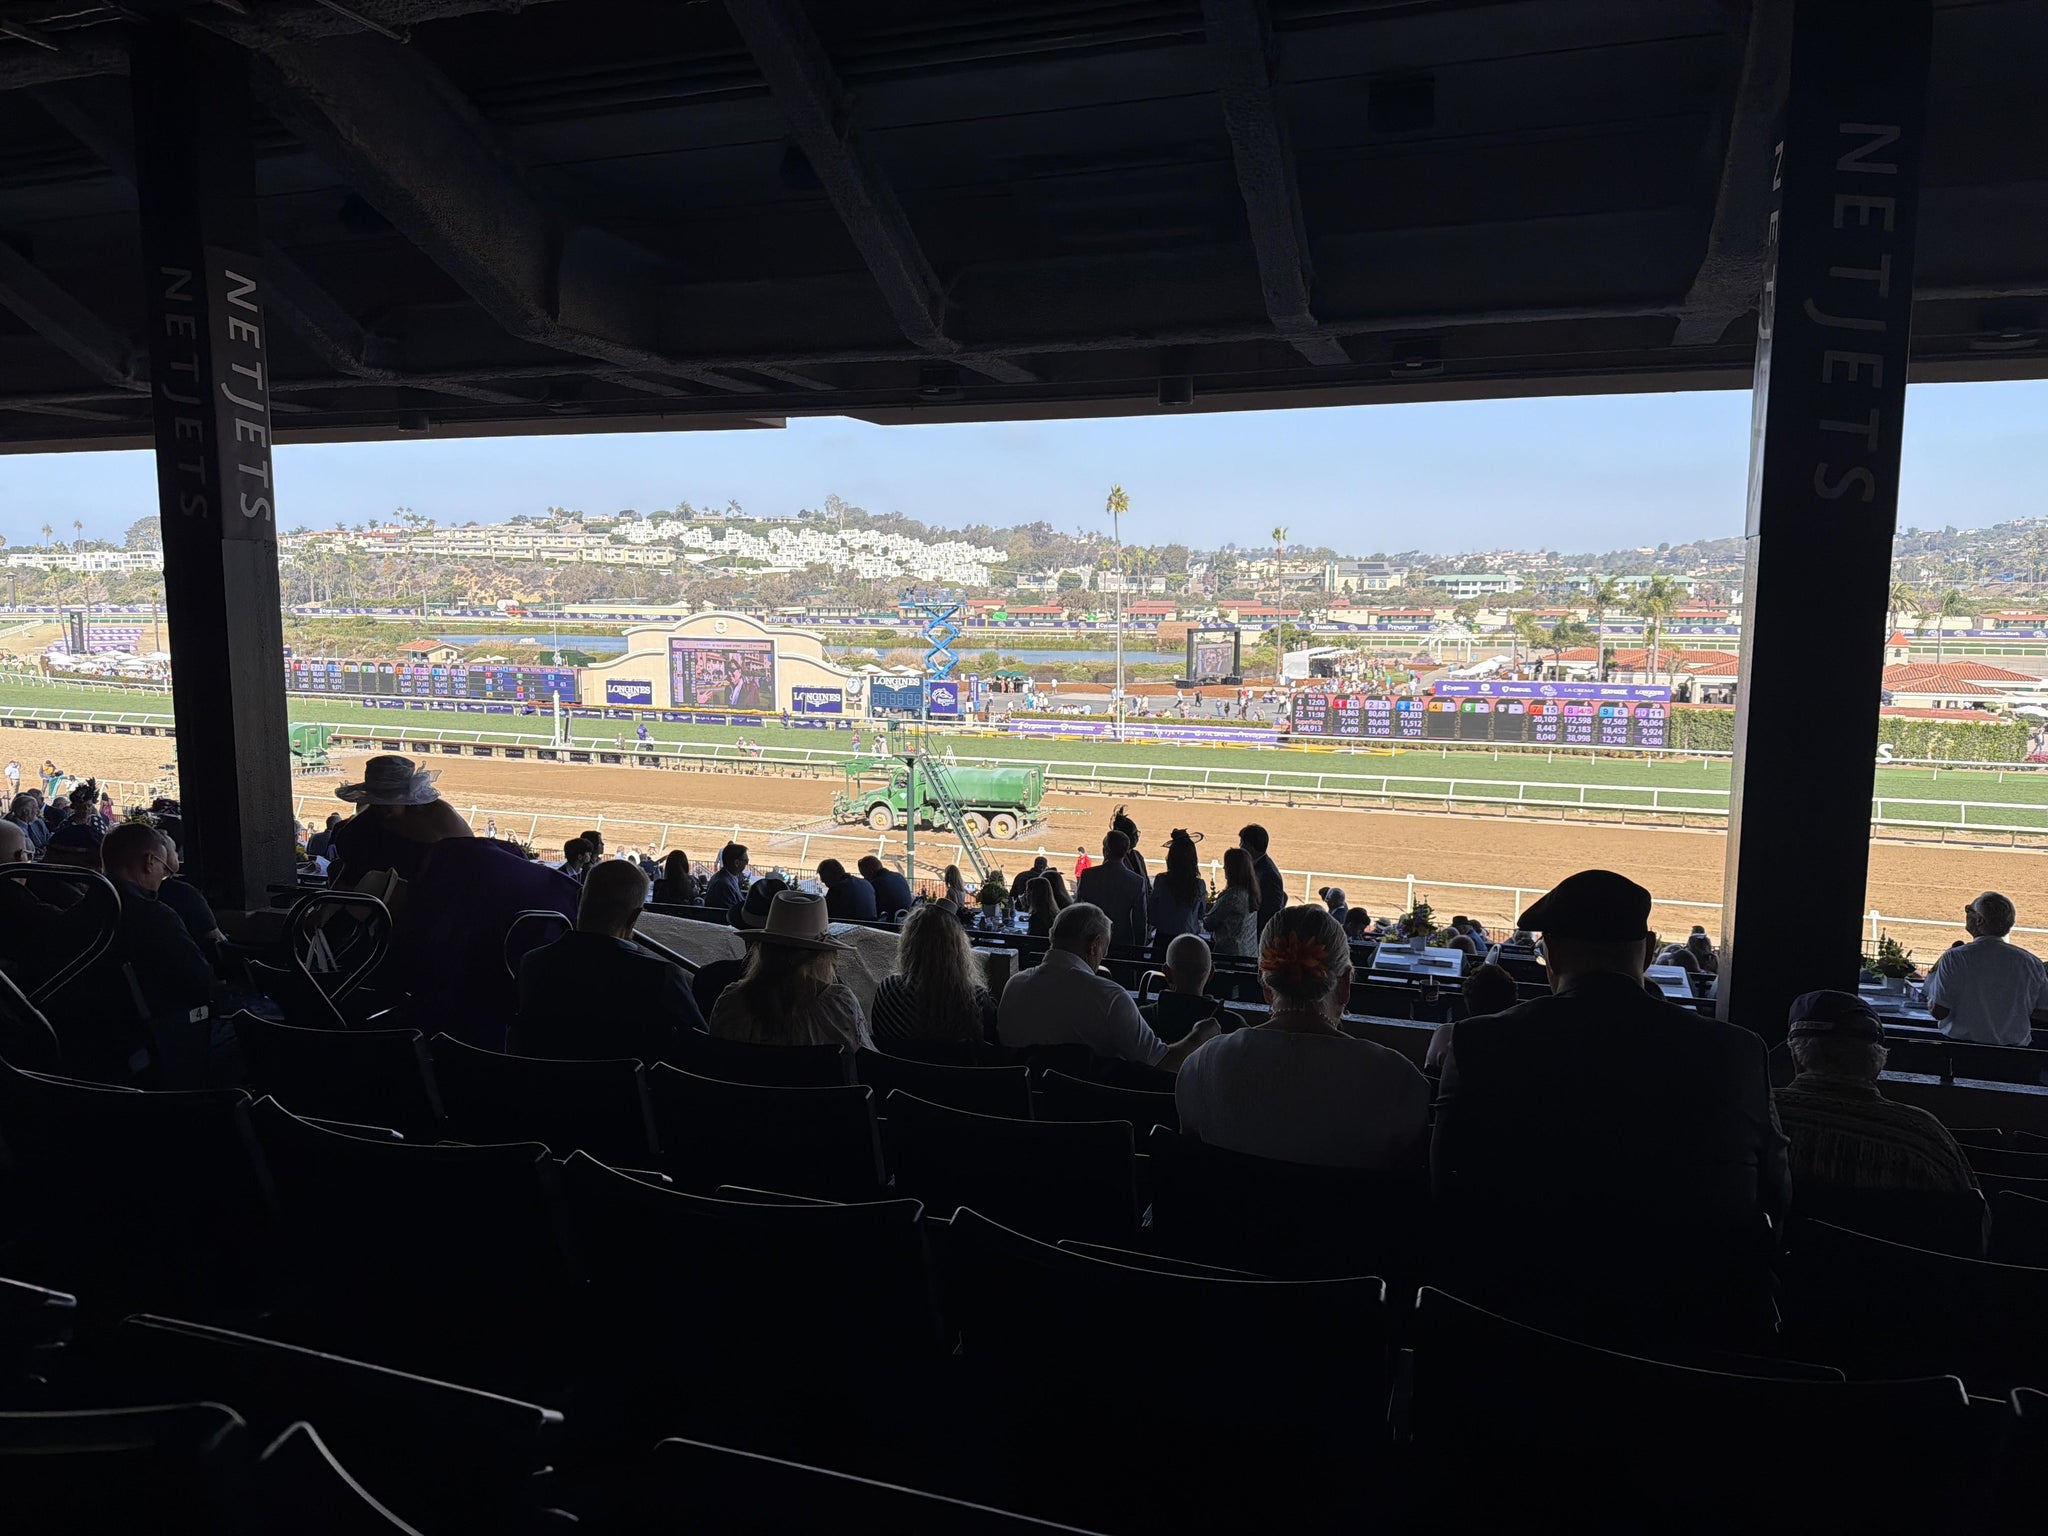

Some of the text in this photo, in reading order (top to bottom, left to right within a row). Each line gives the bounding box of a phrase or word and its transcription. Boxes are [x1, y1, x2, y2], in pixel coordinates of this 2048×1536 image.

[1803, 121, 1900, 502] NETJETS
[160, 265, 208, 520] NETJETS
[220, 269, 272, 521] NETJETS
[874, 677, 920, 686] LONGINES
[608, 685, 650, 695] LONGINES
[794, 692, 841, 702] LONGINES
[1342, 718, 1358, 726] 7,162
[1567, 726, 1591, 734] 37,183
[1602, 726, 1626, 735] 18,452
[1642, 728, 1663, 736] 9,924
[1533, 716, 1558, 724] 20,109
[1564, 716, 1592, 724] 172,598
[1340, 726, 1358, 734] 6,490
[1566, 734, 1590, 742] 38,998
